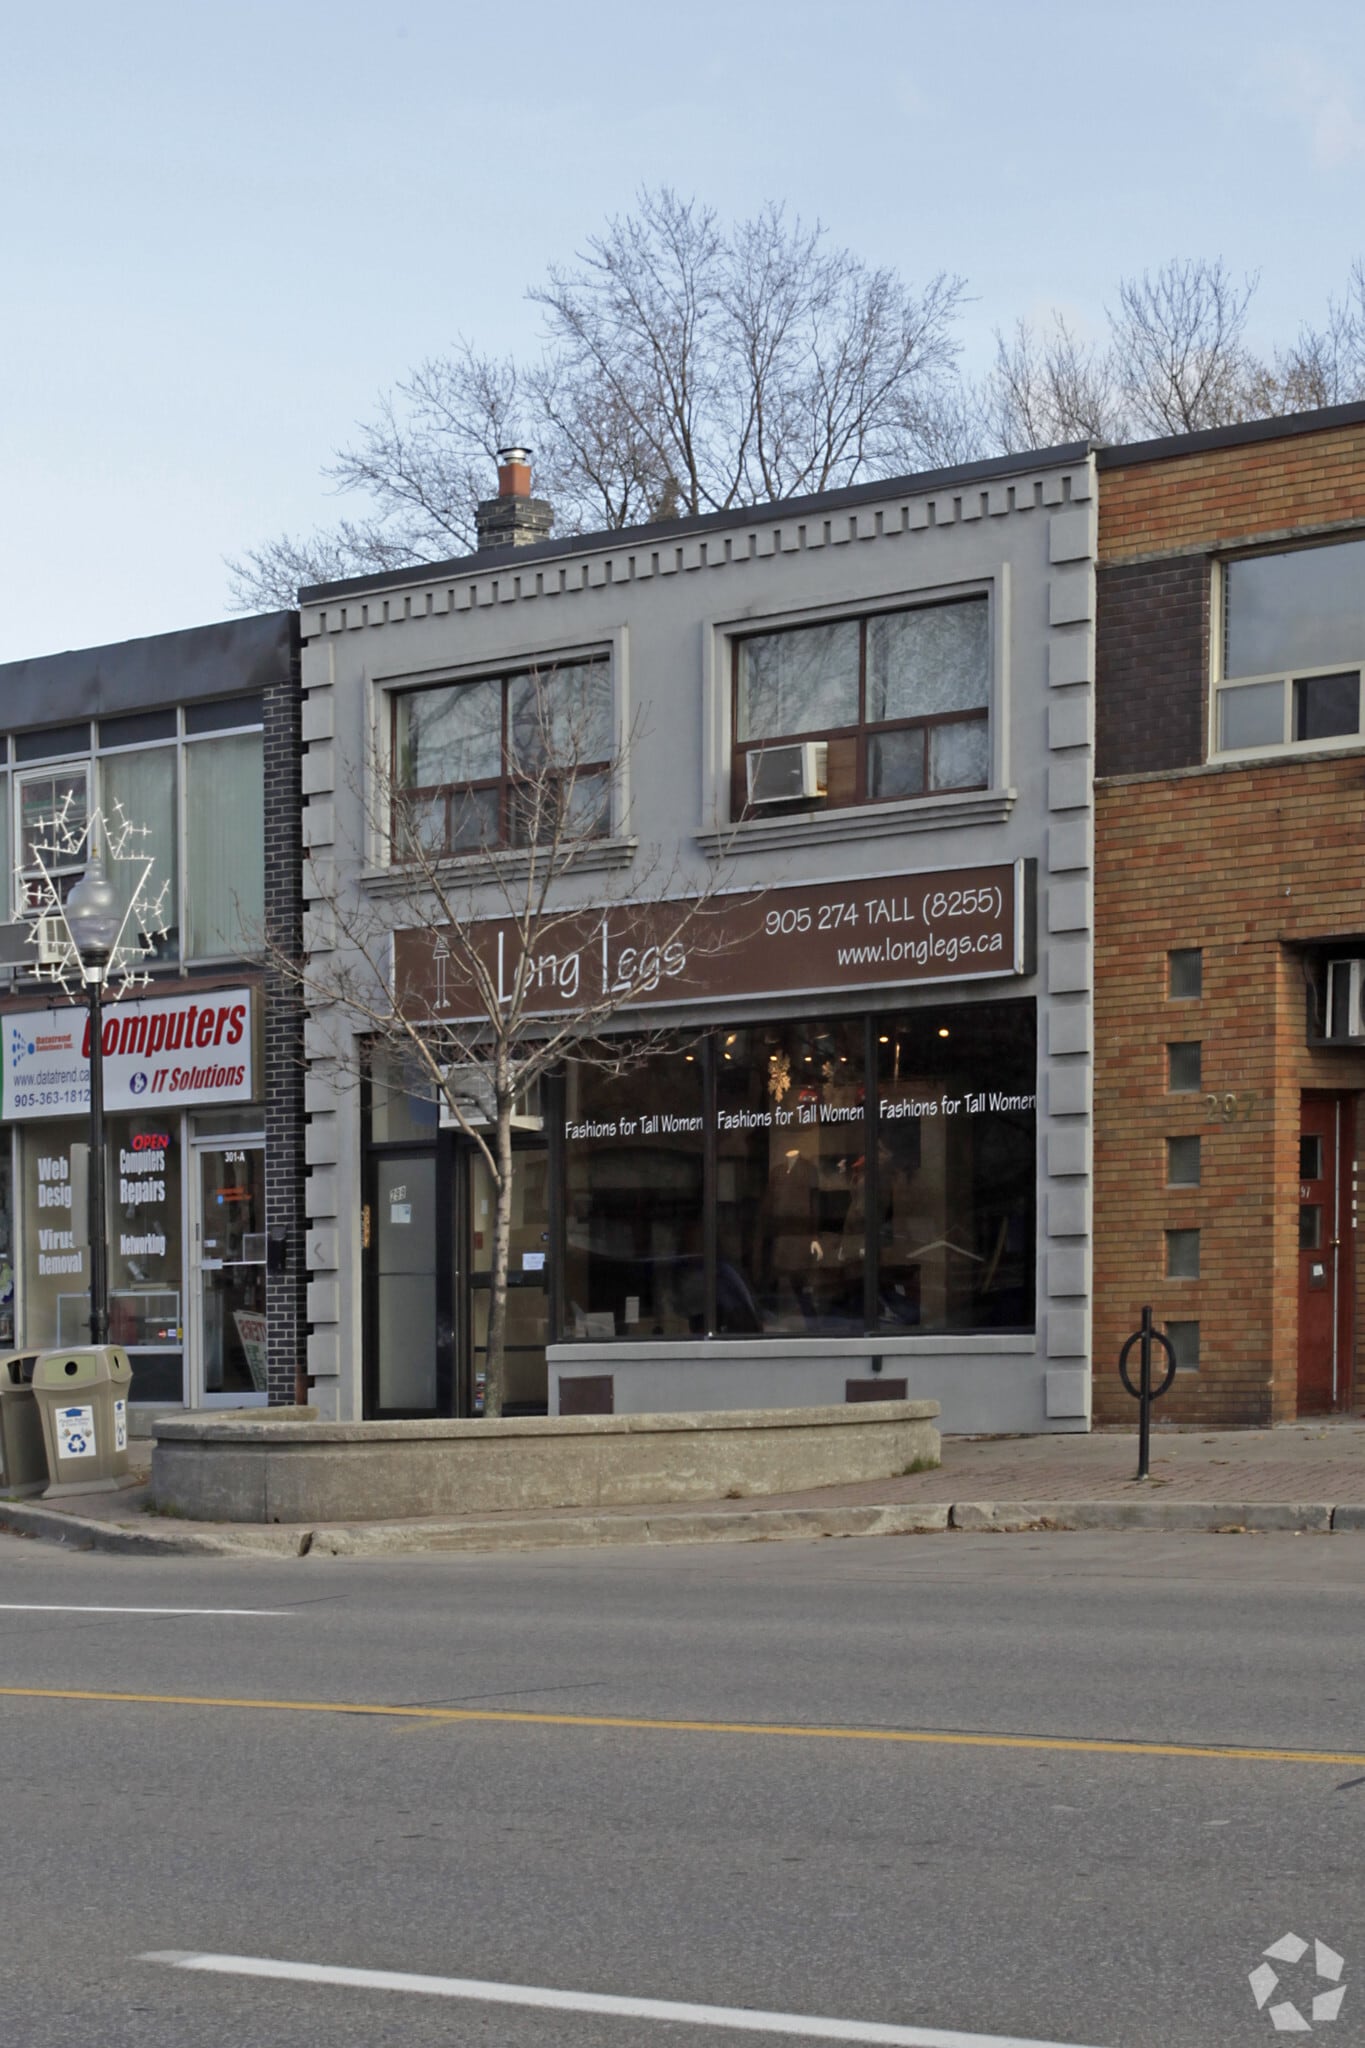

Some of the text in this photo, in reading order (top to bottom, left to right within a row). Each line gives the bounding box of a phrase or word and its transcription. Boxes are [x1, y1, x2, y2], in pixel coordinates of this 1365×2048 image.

[765, 886, 1003, 935] 905 274 TALL (8255)
[498, 921, 686, 1003] Long Legs
[838, 932, 1003, 965] www.longlegs.ca
[13, 1066, 90, 1087] www.datatrend.ca
[151, 1069, 168, 1093] IT
[169, 1064, 245, 1092] Solutions
[14, 1089, 91, 1107] 905-363-1812
[879, 1092, 1036, 1119] Fashions for Tall Women
[1205, 1093, 1258, 1122] 297
[564, 1114, 703, 1139] Fashions for Tall Women
[717, 1103, 864, 1130] Fashions for Tall Women
[132, 1133, 169, 1150] OPEN
[37, 1156, 68, 1182] Web
[120, 1148, 165, 1175] Computers
[224, 1151, 246, 1163] 301-A
[38, 1181, 72, 1209] Desig
[120, 1176, 165, 1206] Repairs
[1300, 1186, 1311, 1199] 97
[120, 1233, 166, 1257] Networking
[38, 1251, 83, 1276] Removal
